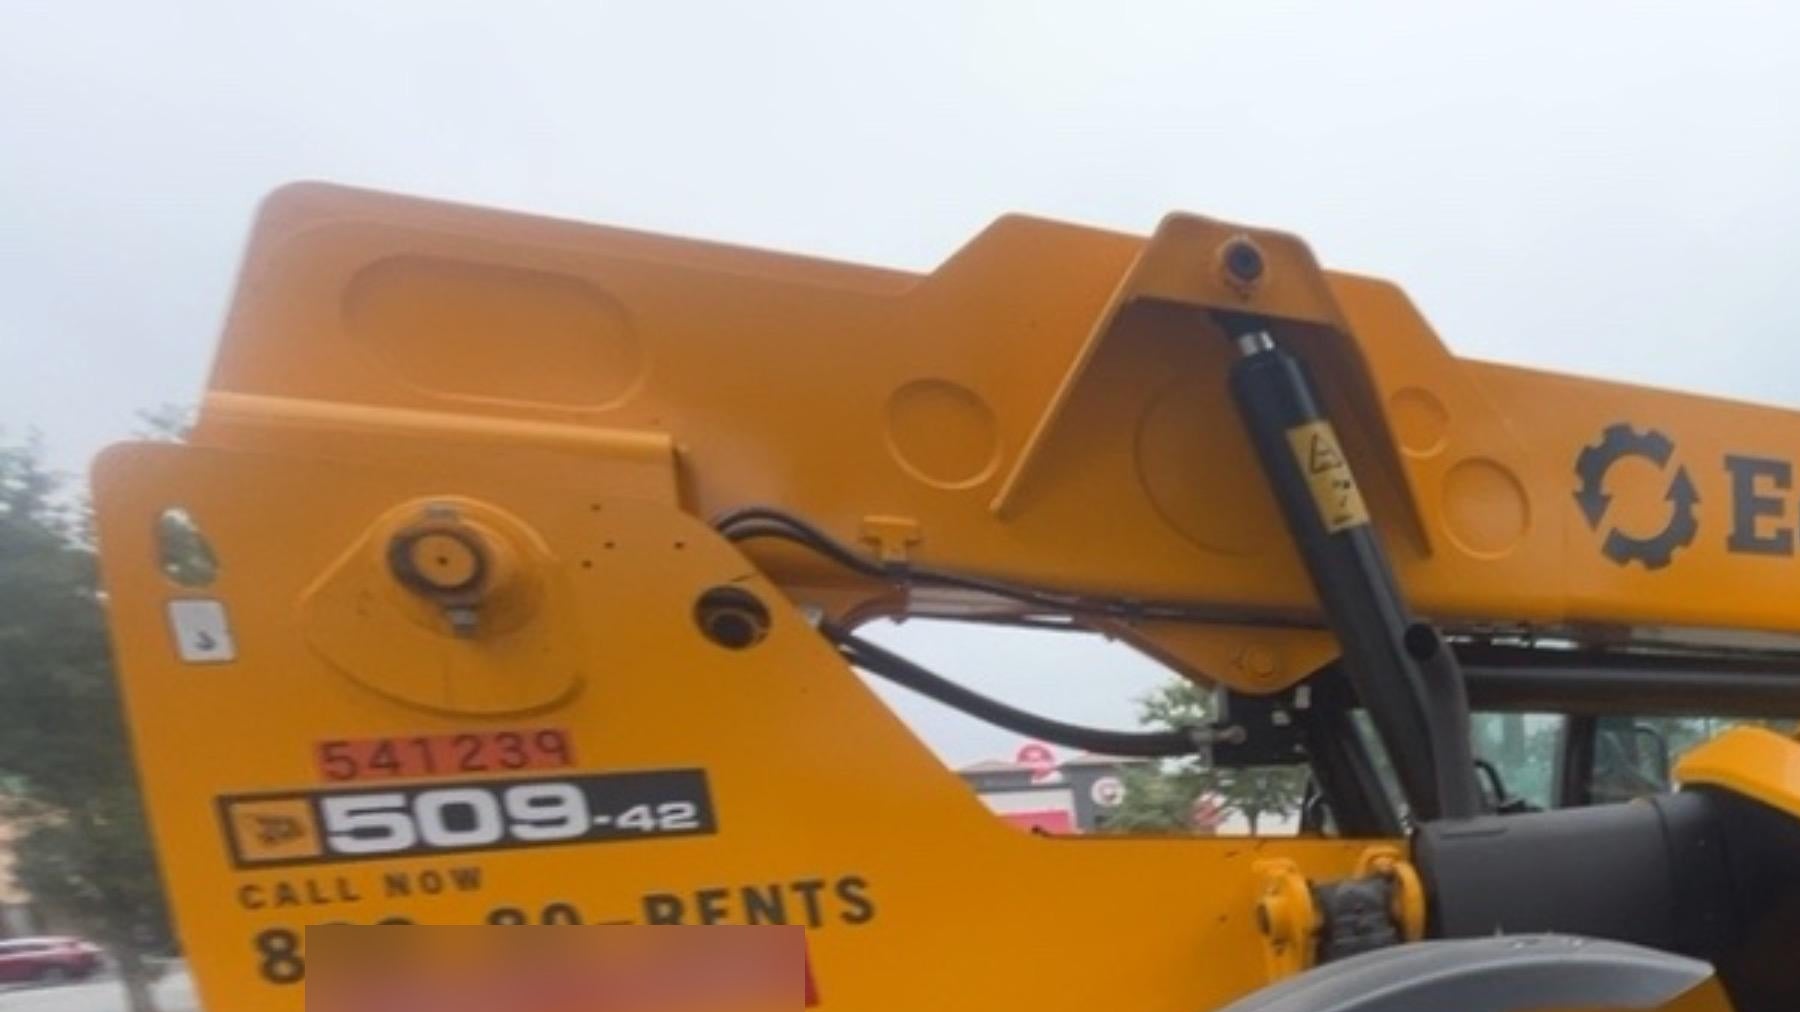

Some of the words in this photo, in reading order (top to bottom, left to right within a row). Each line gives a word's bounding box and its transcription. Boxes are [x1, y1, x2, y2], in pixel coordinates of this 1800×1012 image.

[320, 727, 574, 781] 541239
[321, 782, 699, 865] 509-42
[237, 876, 362, 910] CALL
[384, 867, 483, 898] NOW
